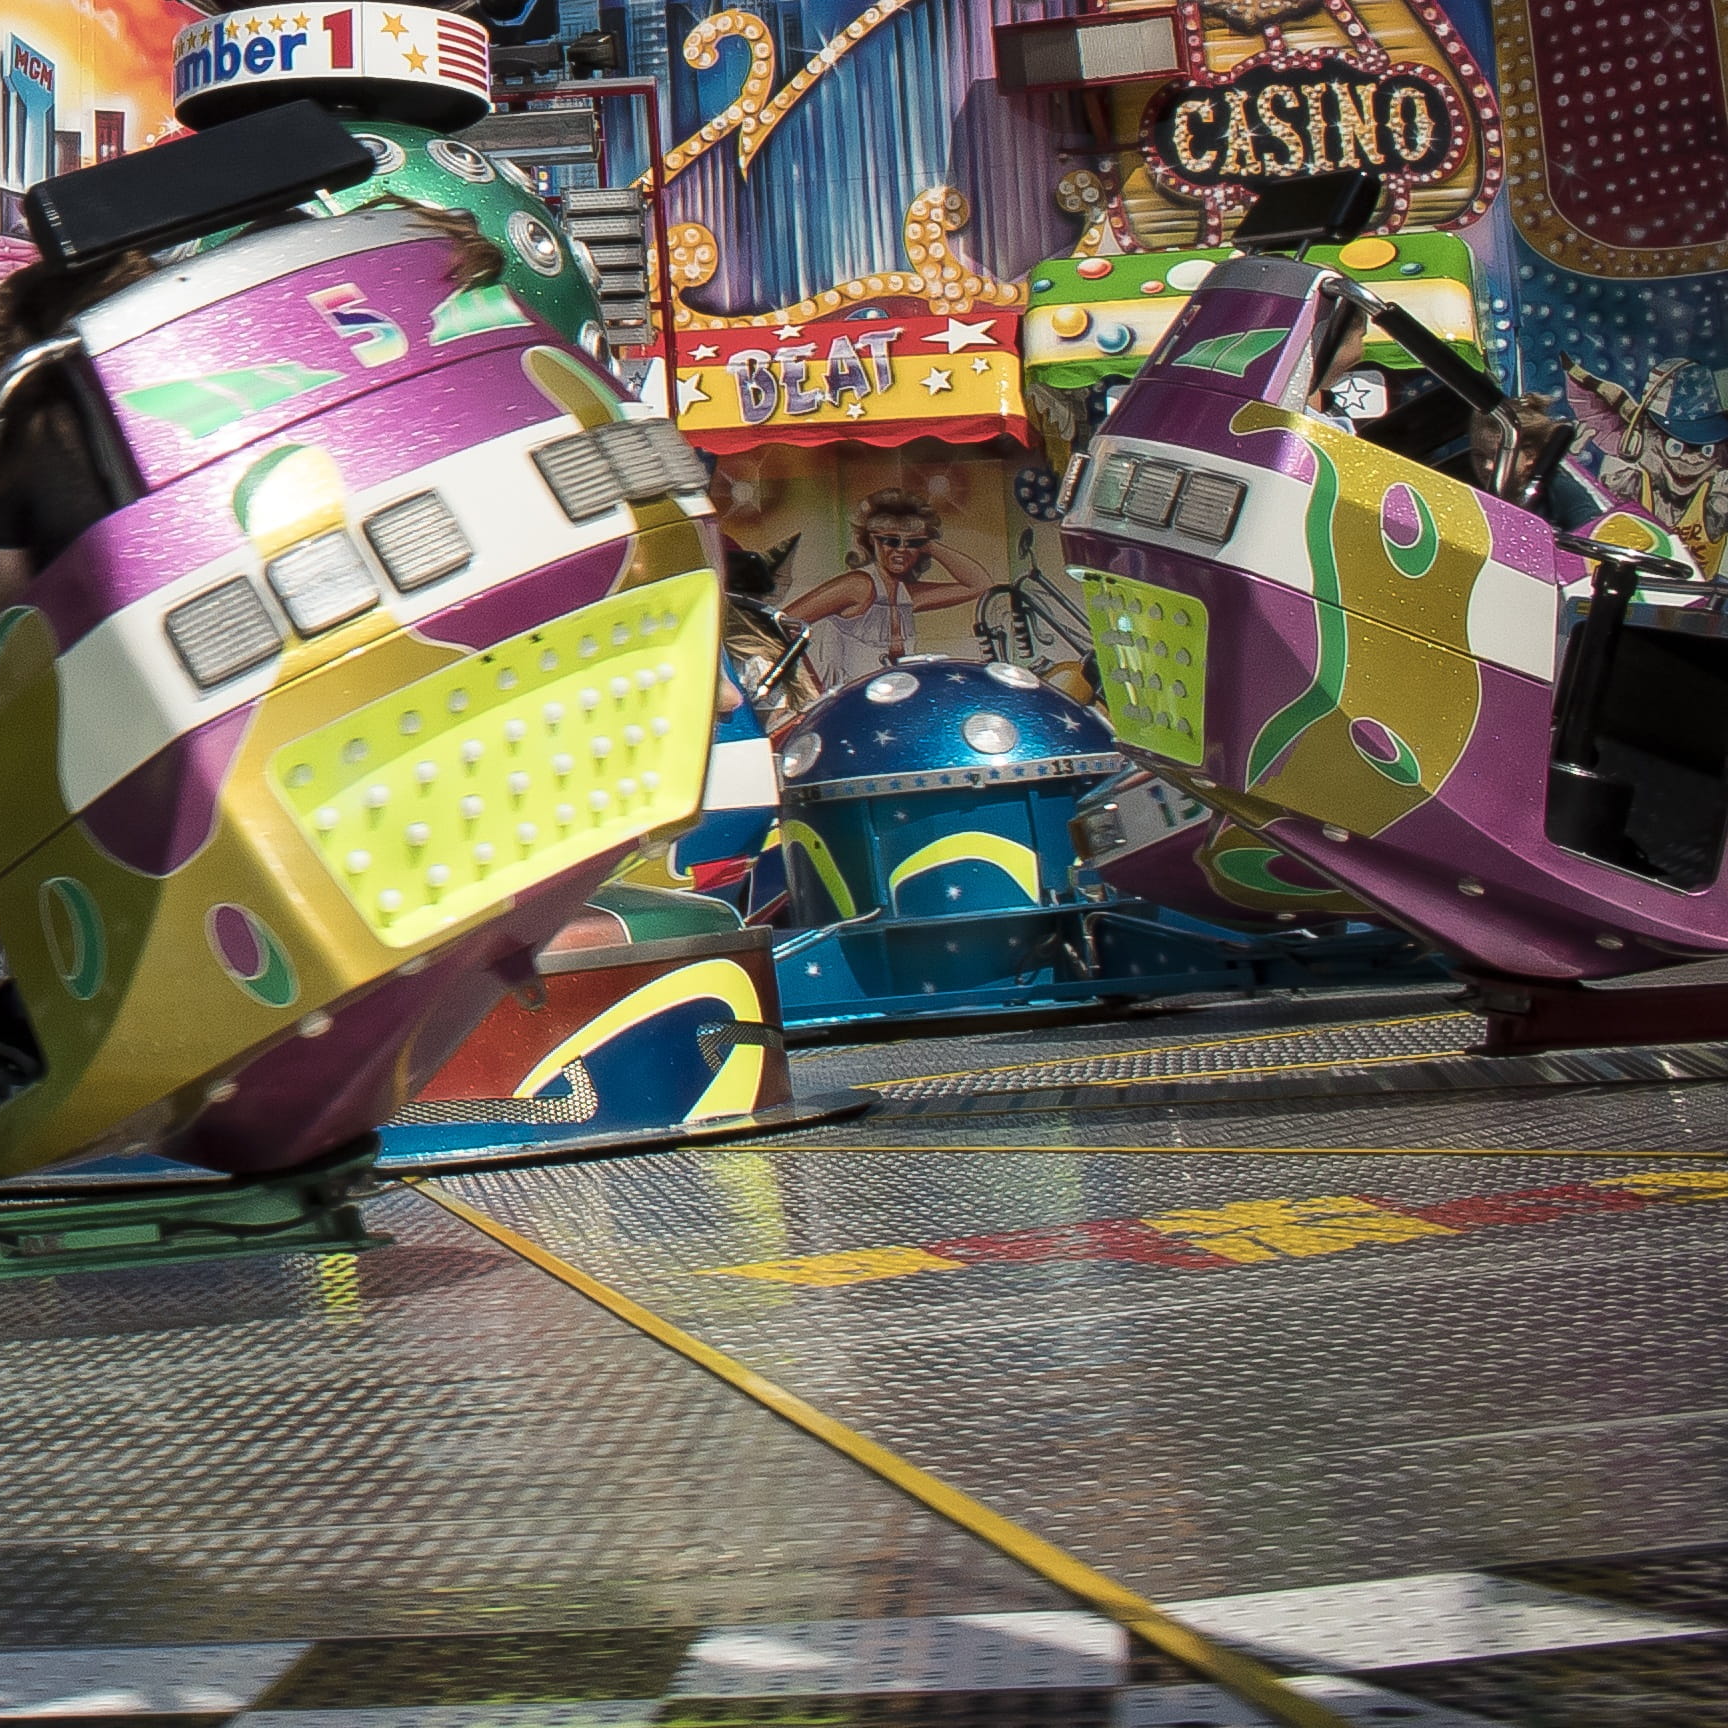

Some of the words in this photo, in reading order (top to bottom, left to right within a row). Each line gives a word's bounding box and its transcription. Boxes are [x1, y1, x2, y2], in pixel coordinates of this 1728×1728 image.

[14, 44, 55, 92] MGM
[322, 7, 353, 70] 1
[1173, 80, 1434, 177] CASINO
[305, 282, 410, 369] 5
[724, 327, 905, 425] BEAT
